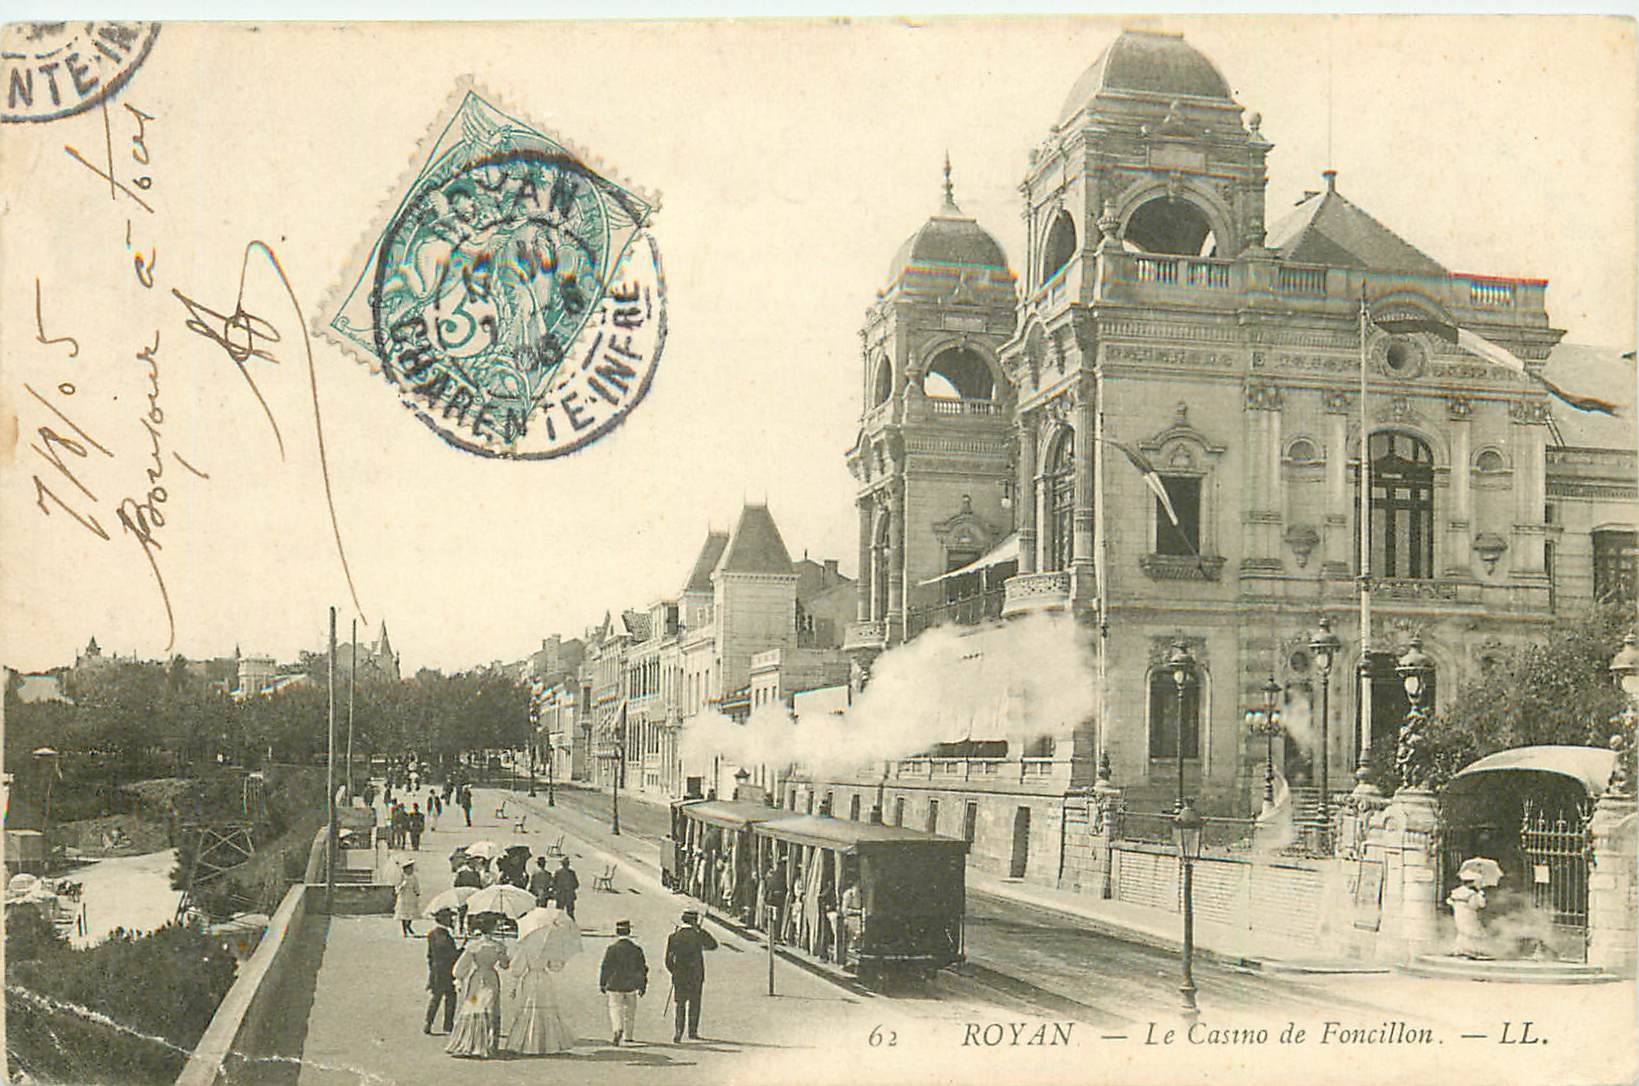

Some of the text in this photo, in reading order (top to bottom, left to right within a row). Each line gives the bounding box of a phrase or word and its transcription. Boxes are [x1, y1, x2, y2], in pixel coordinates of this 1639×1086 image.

[64, 86, 156, 214] tous
[438, 291, 482, 349] 5
[115, 331, 208, 651] Bonjour
